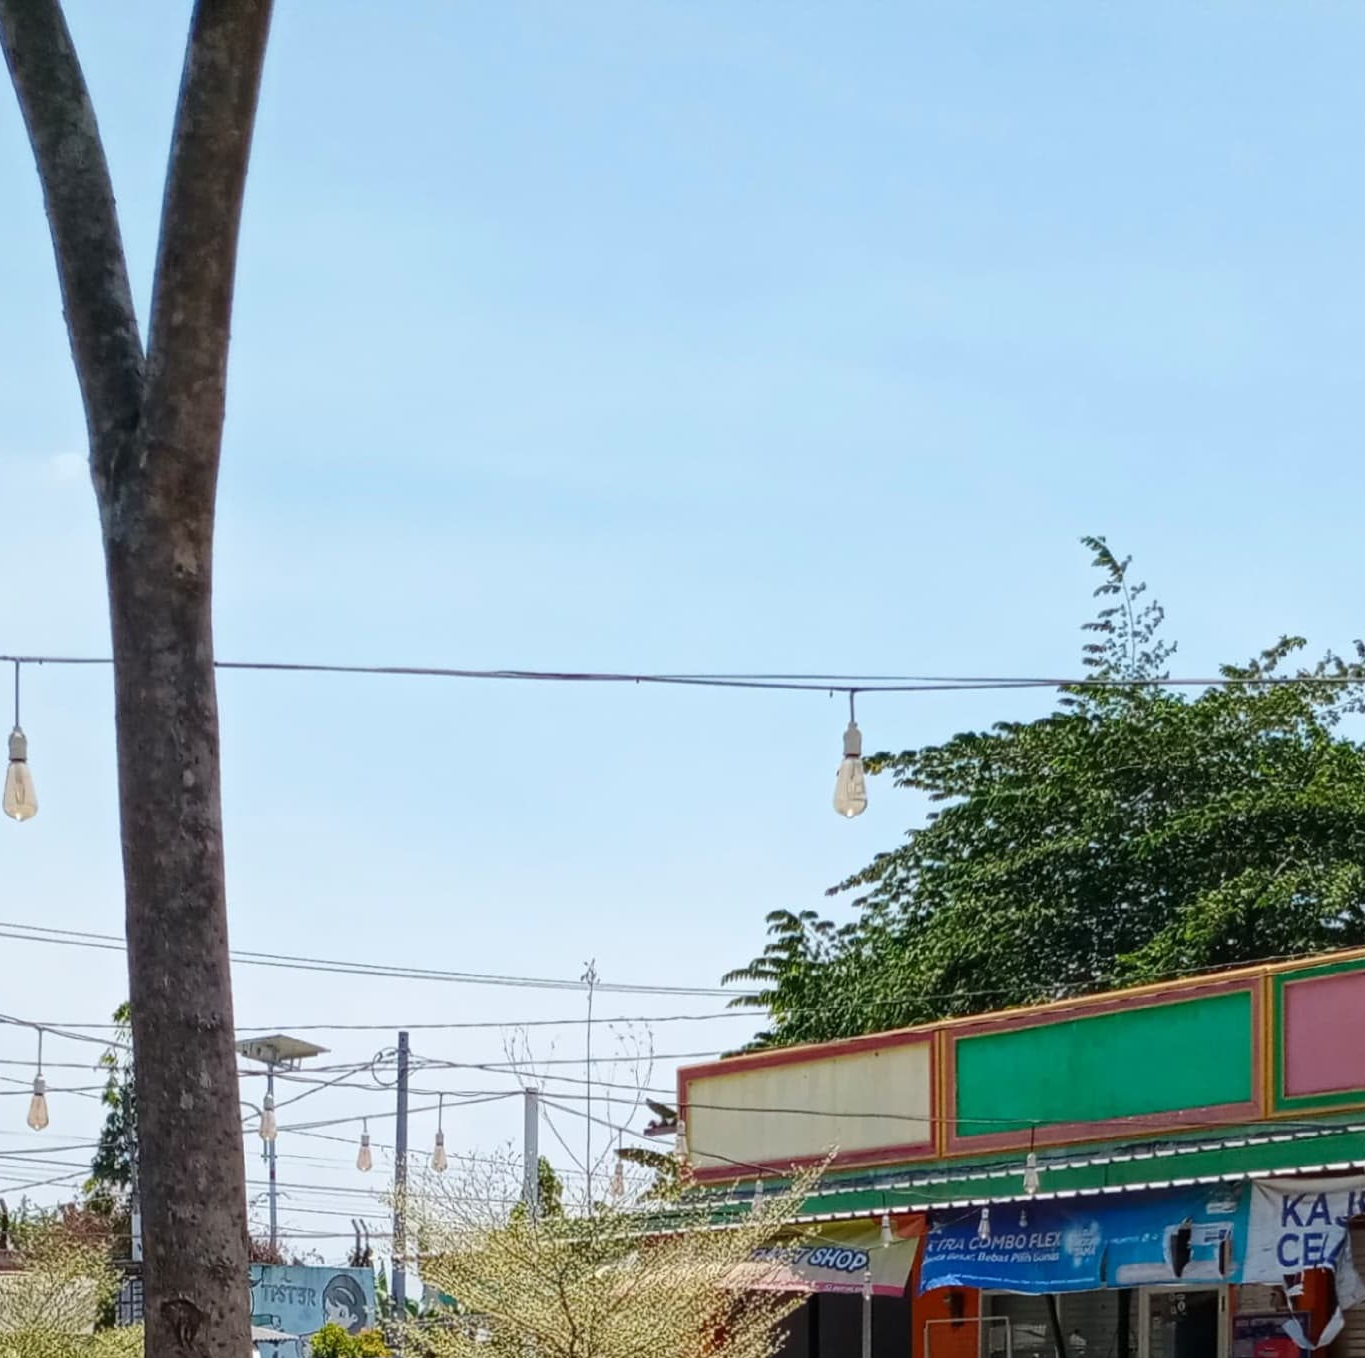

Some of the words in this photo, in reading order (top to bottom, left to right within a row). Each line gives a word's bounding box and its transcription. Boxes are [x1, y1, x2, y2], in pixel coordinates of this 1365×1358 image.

[969, 1233, 1027, 1251] COMBO
[1029, 1232, 1061, 1248] FLEX
[810, 1247, 867, 1271] SHOP
